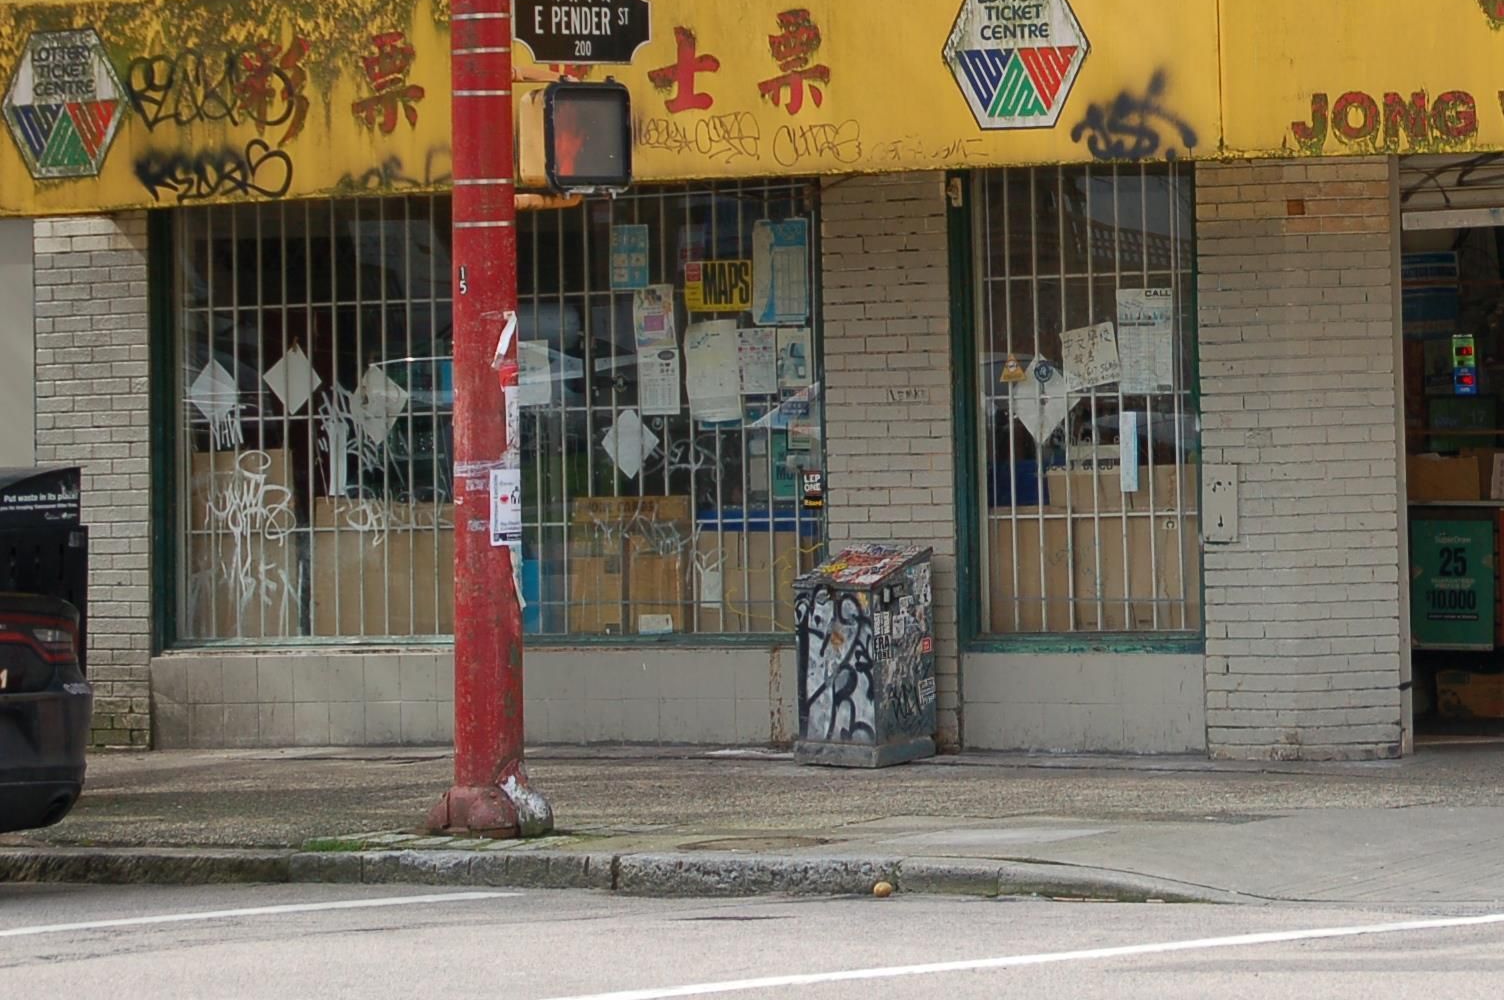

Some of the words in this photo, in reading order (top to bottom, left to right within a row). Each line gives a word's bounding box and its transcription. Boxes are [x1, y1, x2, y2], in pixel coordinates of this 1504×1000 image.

[535, 5, 544, 34] E
[552, 5, 611, 36] PENDER
[618, 8, 629, 25] ST
[984, 3, 1044, 20] TICKET
[980, 21, 1049, 41] CENTRE
[30, 47, 93, 63] LOTTERY
[575, 41, 592, 56] 200
[37, 62, 90, 78] TICKET
[33, 79, 96, 97] CENTRE
[1291, 90, 1478, 141] JONG
[702, 262, 750, 305] MAPS
[1144, 290, 1171, 298] CALL
[1439, 547, 1468, 577] 25
